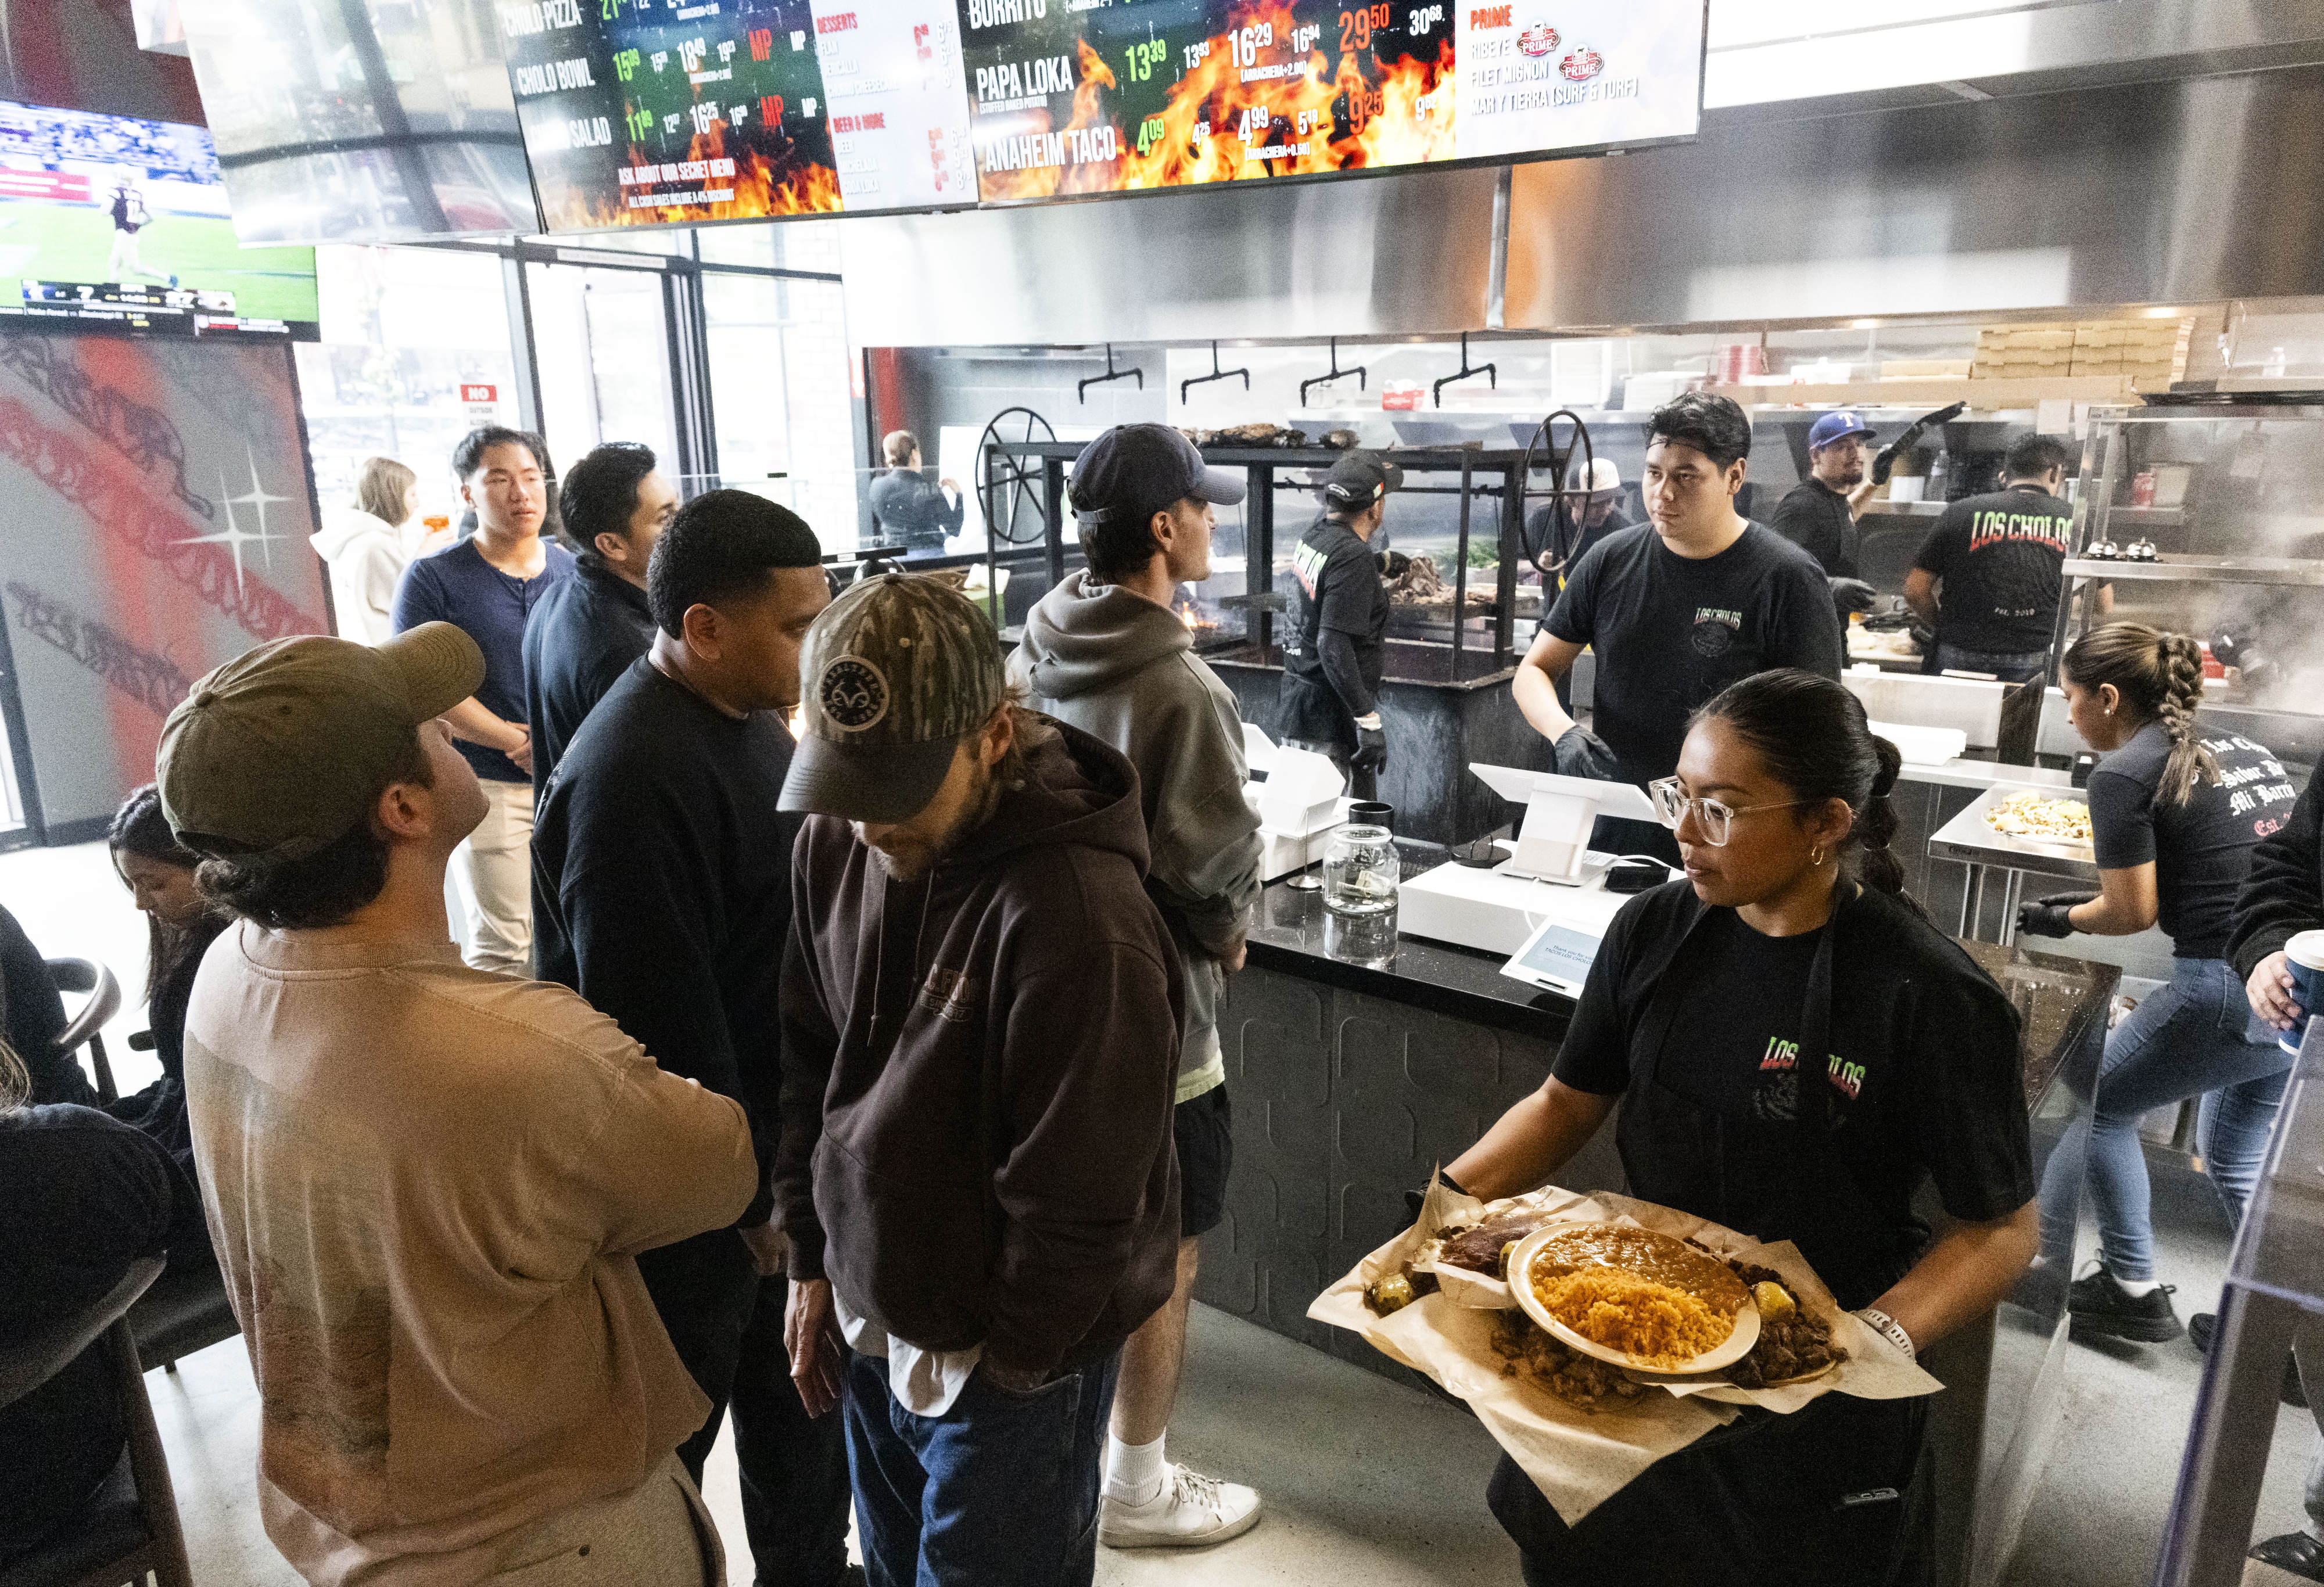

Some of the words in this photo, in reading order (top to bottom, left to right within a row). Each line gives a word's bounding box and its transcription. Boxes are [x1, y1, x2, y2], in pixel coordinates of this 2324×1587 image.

[504, 3, 545, 37] CHOLO
[543, 0, 582, 30] PIZZA
[816, 12, 858, 34] DESSERTS
[969, 0, 1047, 29] BURRITO
[1471, 4, 1514, 31] PRIME
[975, 63, 1023, 102] PAPA
[1024, 55, 1074, 96] LOKA
[1125, 38, 1167, 82] 1339
[1183, 41, 1210, 69] 1393
[1228, 22, 1272, 67] 1629
[1291, 24, 1320, 53] 1694
[1339, 3, 1390, 52] 2950
[1409, 5, 1443, 36] 3068
[1472, 38, 1511, 59] RIBEYE
[1522, 39, 1554, 53] PRIME
[516, 63, 558, 95] CHOLO
[555, 58, 596, 90] BOWL
[677, 37, 706, 73] 1849
[748, 29, 772, 61] MP
[790, 30, 806, 52] MP
[1472, 67, 1501, 87] FILET
[1504, 59, 1549, 84] MIGNON
[1565, 63, 1597, 77] PRIME
[1471, 96, 1497, 116] MAR
[1498, 95, 1507, 112] Y
[1509, 88, 1550, 112] TIERRA
[1550, 82, 1588, 107] (SURF
[1588, 81, 1598, 102] &
[1601, 76, 1640, 99] TURF)
[569, 117, 612, 148] SALAD
[689, 101, 719, 135] 1625
[761, 95, 784, 126] MP
[801, 97, 817, 117] MP
[833, 116, 854, 133] BEER
[862, 112, 886, 130] MORE
[985, 131, 1066, 172] ANAHEIM
[1068, 125, 1117, 164] TACO
[1136, 118, 1165, 156] 409
[1192, 121, 1211, 146] 425
[1238, 105, 1269, 146] 499
[1298, 109, 1318, 135] 519
[1349, 90, 1385, 135] 925
[1415, 94, 1437, 121] 962
[618, 167, 636, 186] ASK
[634, 164, 662, 185] ABOUT
[678, 160, 710, 181] SECRET
[709, 157, 736, 178] MENU
[468, 387, 489, 400] NO
[1970, 511, 2007, 552] LOS
[1694, 608, 1712, 624] LOS
[1710, 608, 1742, 631] CHOLOS
[1545, 947, 1562, 956] TACOS
[1552, 945, 1567, 953] Thank
[1759, 1036, 1799, 1070] LOS
